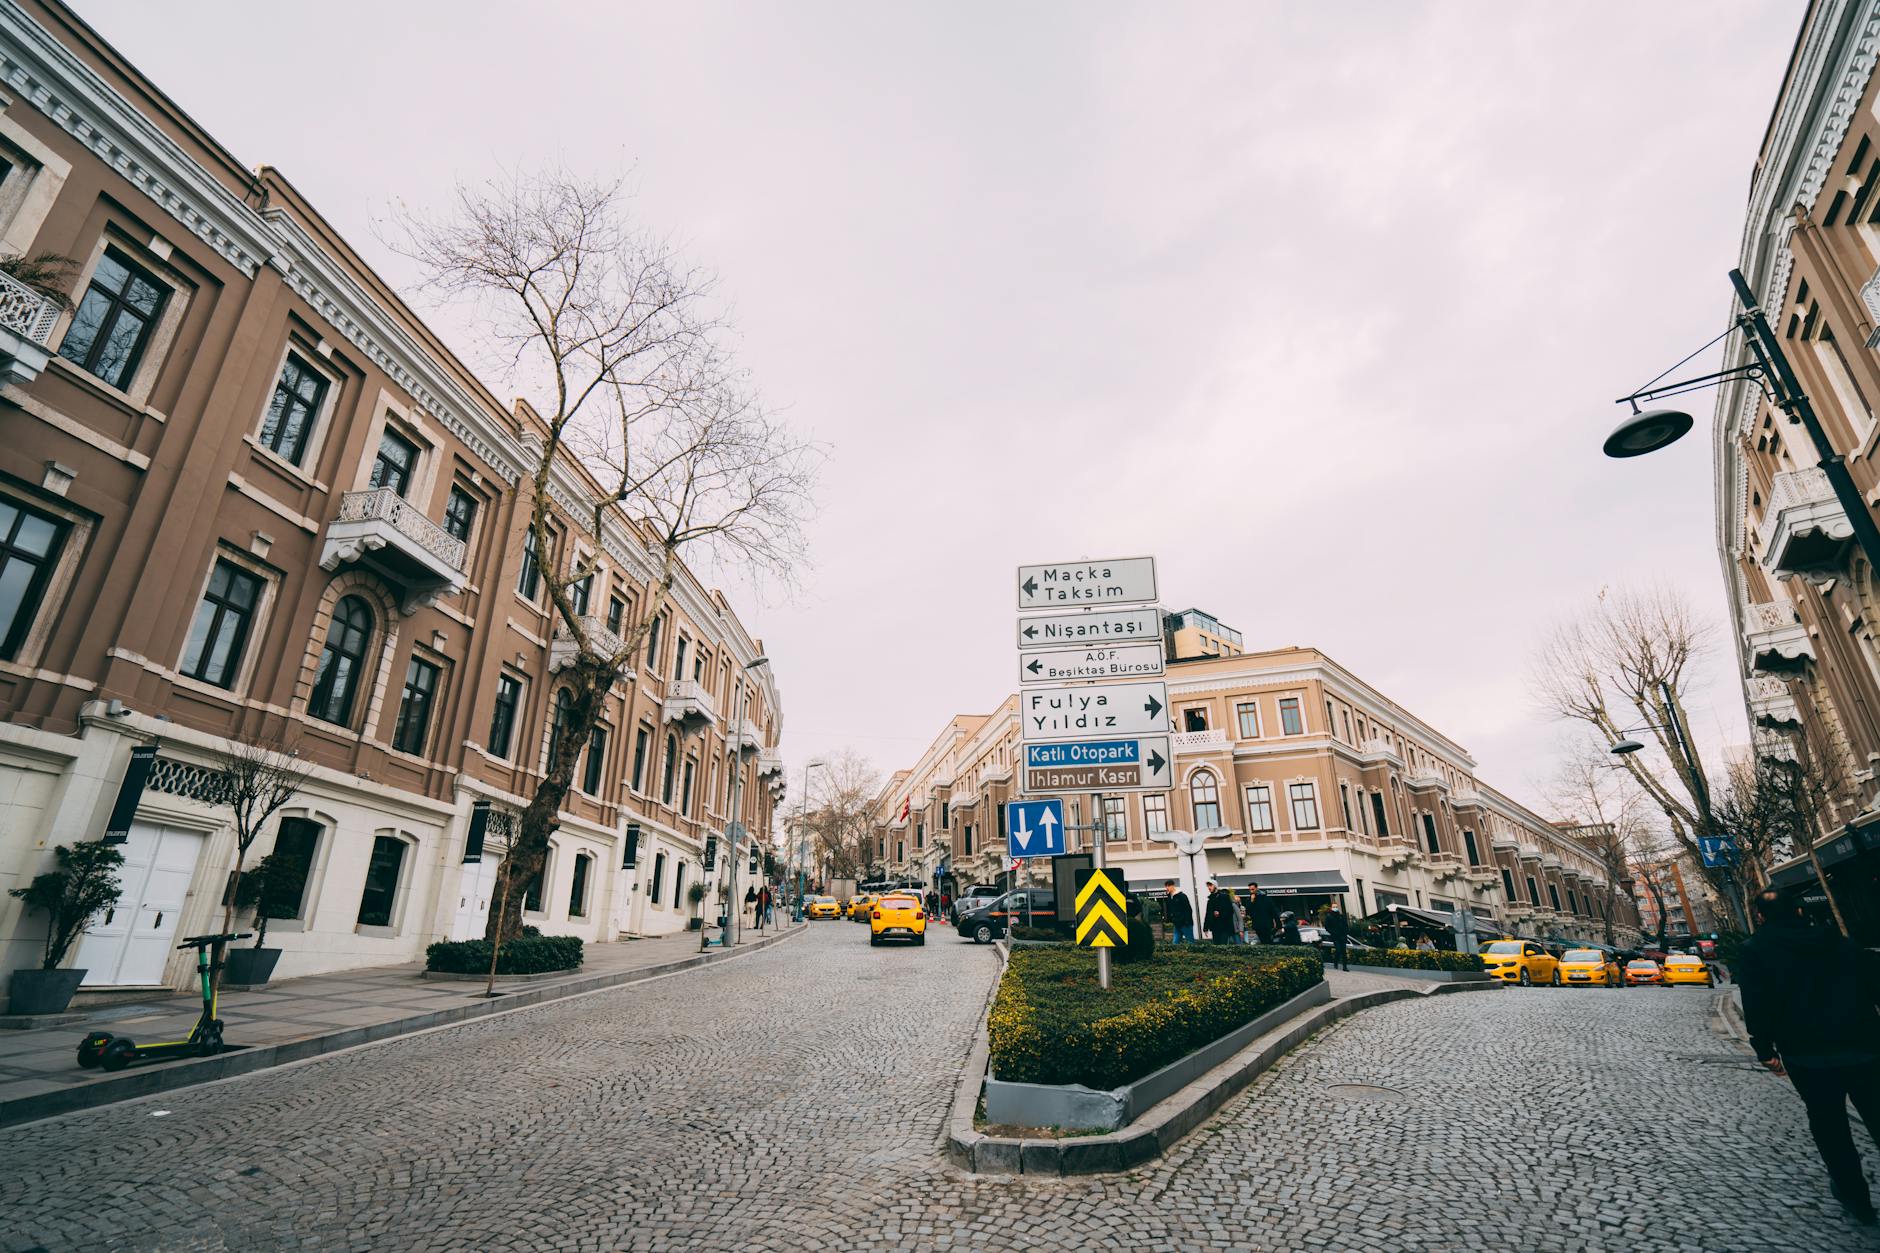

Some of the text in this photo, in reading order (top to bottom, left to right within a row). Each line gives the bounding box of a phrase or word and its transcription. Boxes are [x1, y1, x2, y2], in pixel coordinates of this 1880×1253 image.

[1044, 567, 1112, 583] Maçka
[1045, 586, 1123, 600] Taksim
[1045, 621, 1142, 638] Nişantaşı
[1086, 649, 1119, 662] A.Ö.F.
[1049, 662, 1158, 677] Beşiktaş Bürosu
[1032, 694, 1108, 711] Fulya
[1033, 714, 1117, 731] Yıldız
[1031, 744, 1133, 762] Katlı Otopark
[1031, 768, 1137, 787] Ihlamur Kasrı
